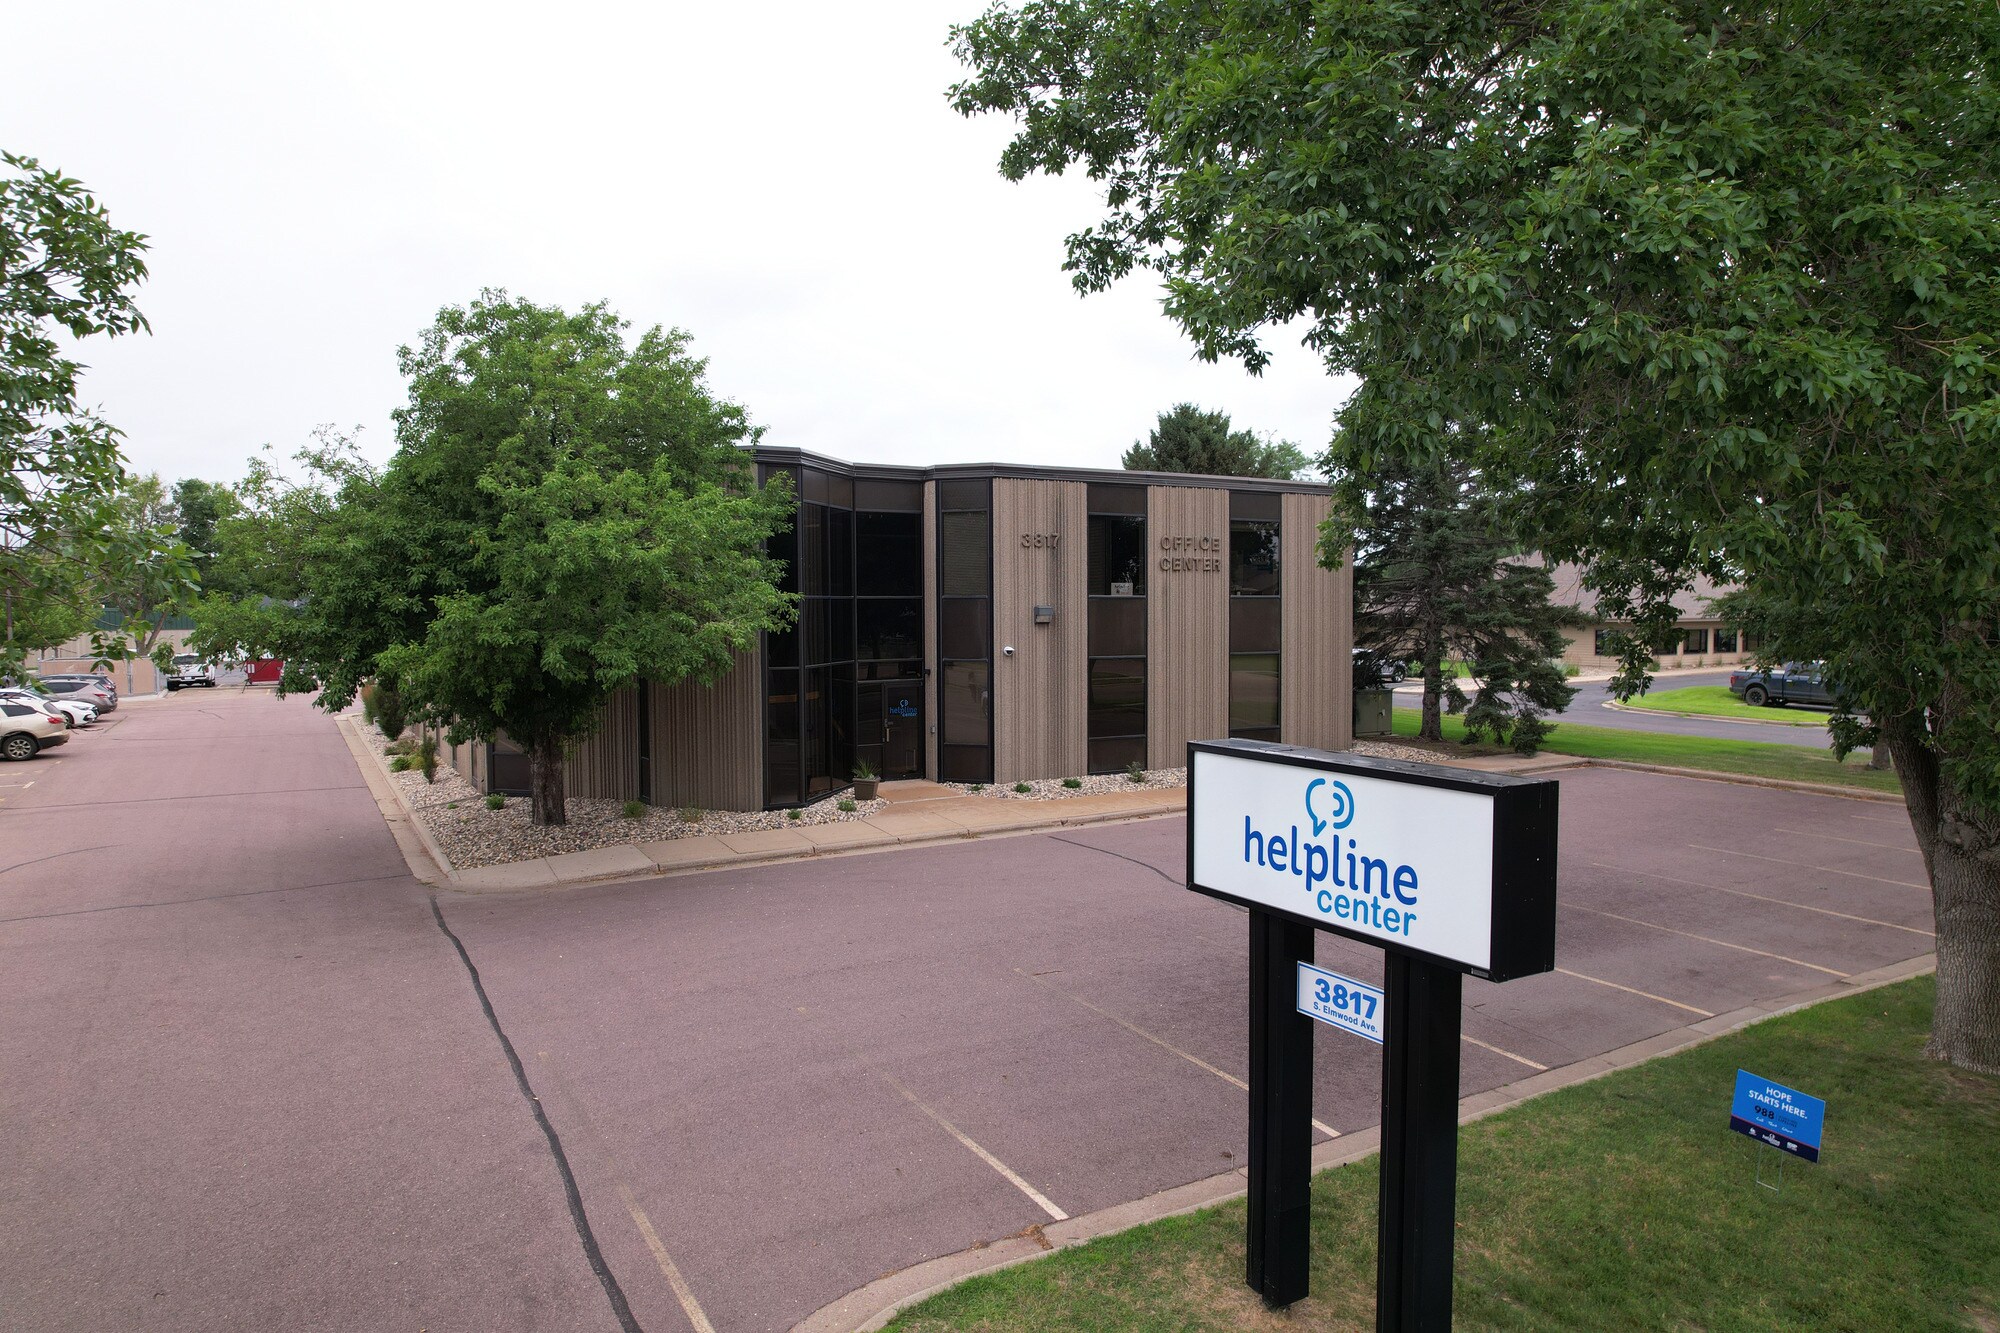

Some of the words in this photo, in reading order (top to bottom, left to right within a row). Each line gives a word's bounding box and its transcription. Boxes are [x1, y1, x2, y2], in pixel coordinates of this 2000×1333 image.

[1021, 532, 1060, 549] 3817
[1161, 535, 1220, 552] OFFICE
[1160, 556, 1221, 572] CENTER
[1244, 815, 1418, 906] helpline
[1316, 889, 1417, 936] center
[1314, 977, 1377, 1020] 3817
[1313, 1001, 1321, 1011] S.
[1323, 1005, 1358, 1025] Elmwood
[1360, 1019, 1378, 1034] Ave.
[1748, 1090, 1780, 1108] STARTS
[1781, 1103, 1808, 1119] HERE.
[1765, 1086, 1792, 1103] HOPE
[1754, 1105, 1775, 1120] 988
